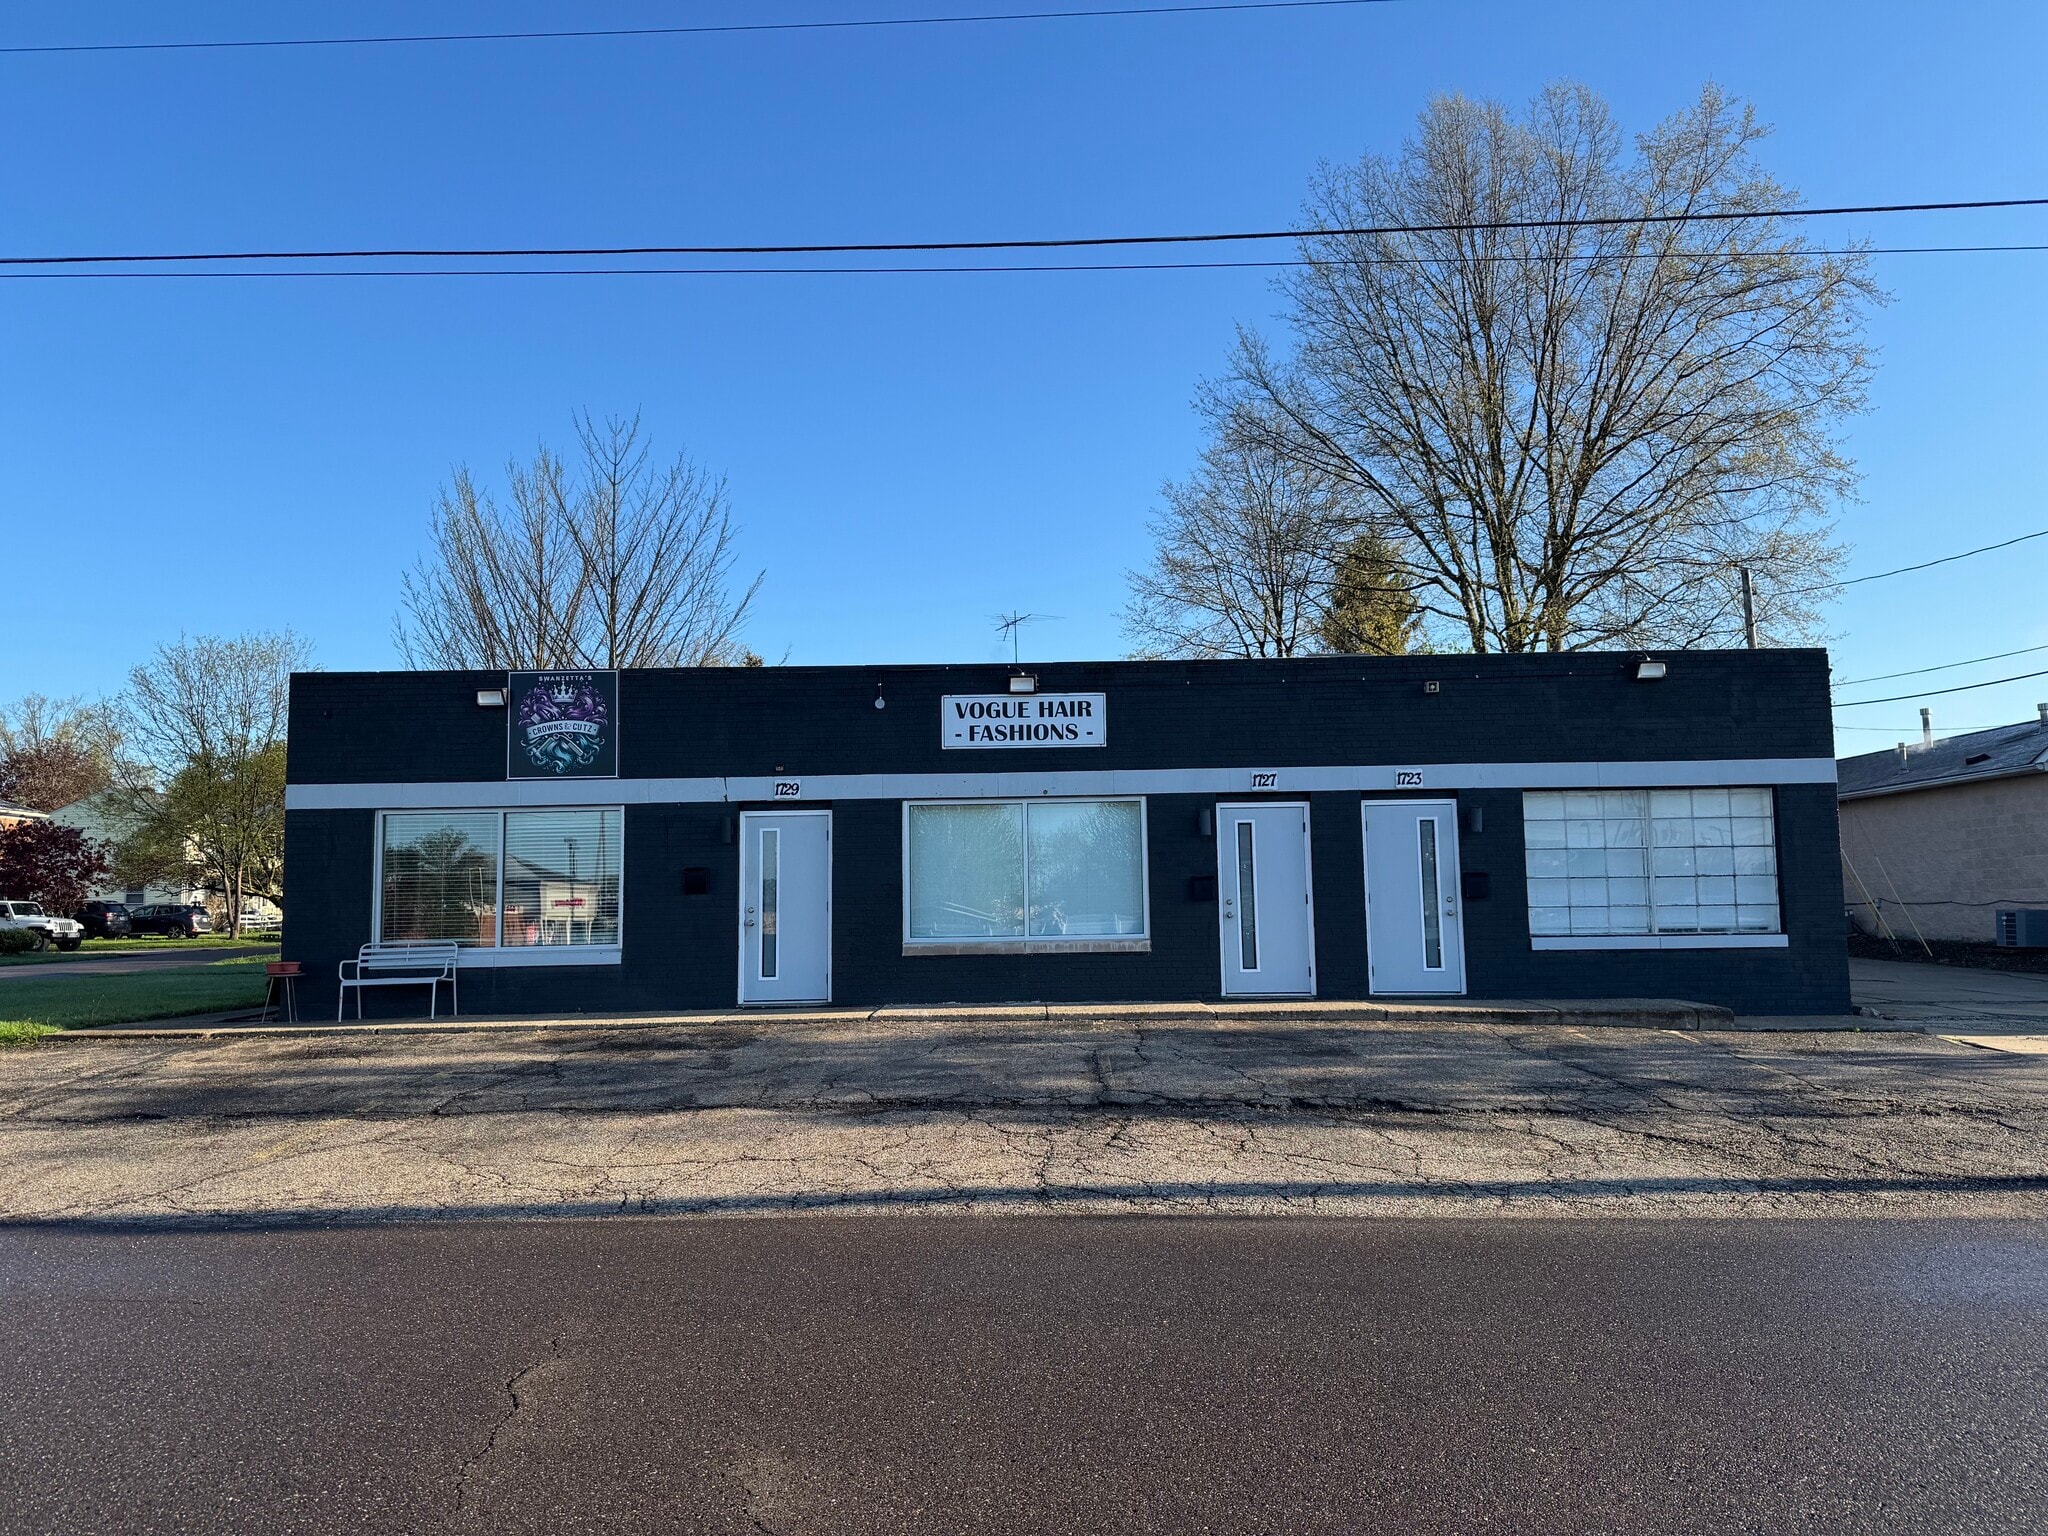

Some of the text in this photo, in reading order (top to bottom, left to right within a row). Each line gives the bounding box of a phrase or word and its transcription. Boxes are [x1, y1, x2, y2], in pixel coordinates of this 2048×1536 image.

[955, 700, 1092, 719] VOGUE HAIR
[532, 722, 564, 736] CROWNS
[572, 722, 593, 733] CUTZ
[968, 723, 1079, 742] FASHIONS
[1252, 773, 1277, 787] 1727
[1397, 772, 1422, 785] 1723
[775, 782, 800, 796] 1729
